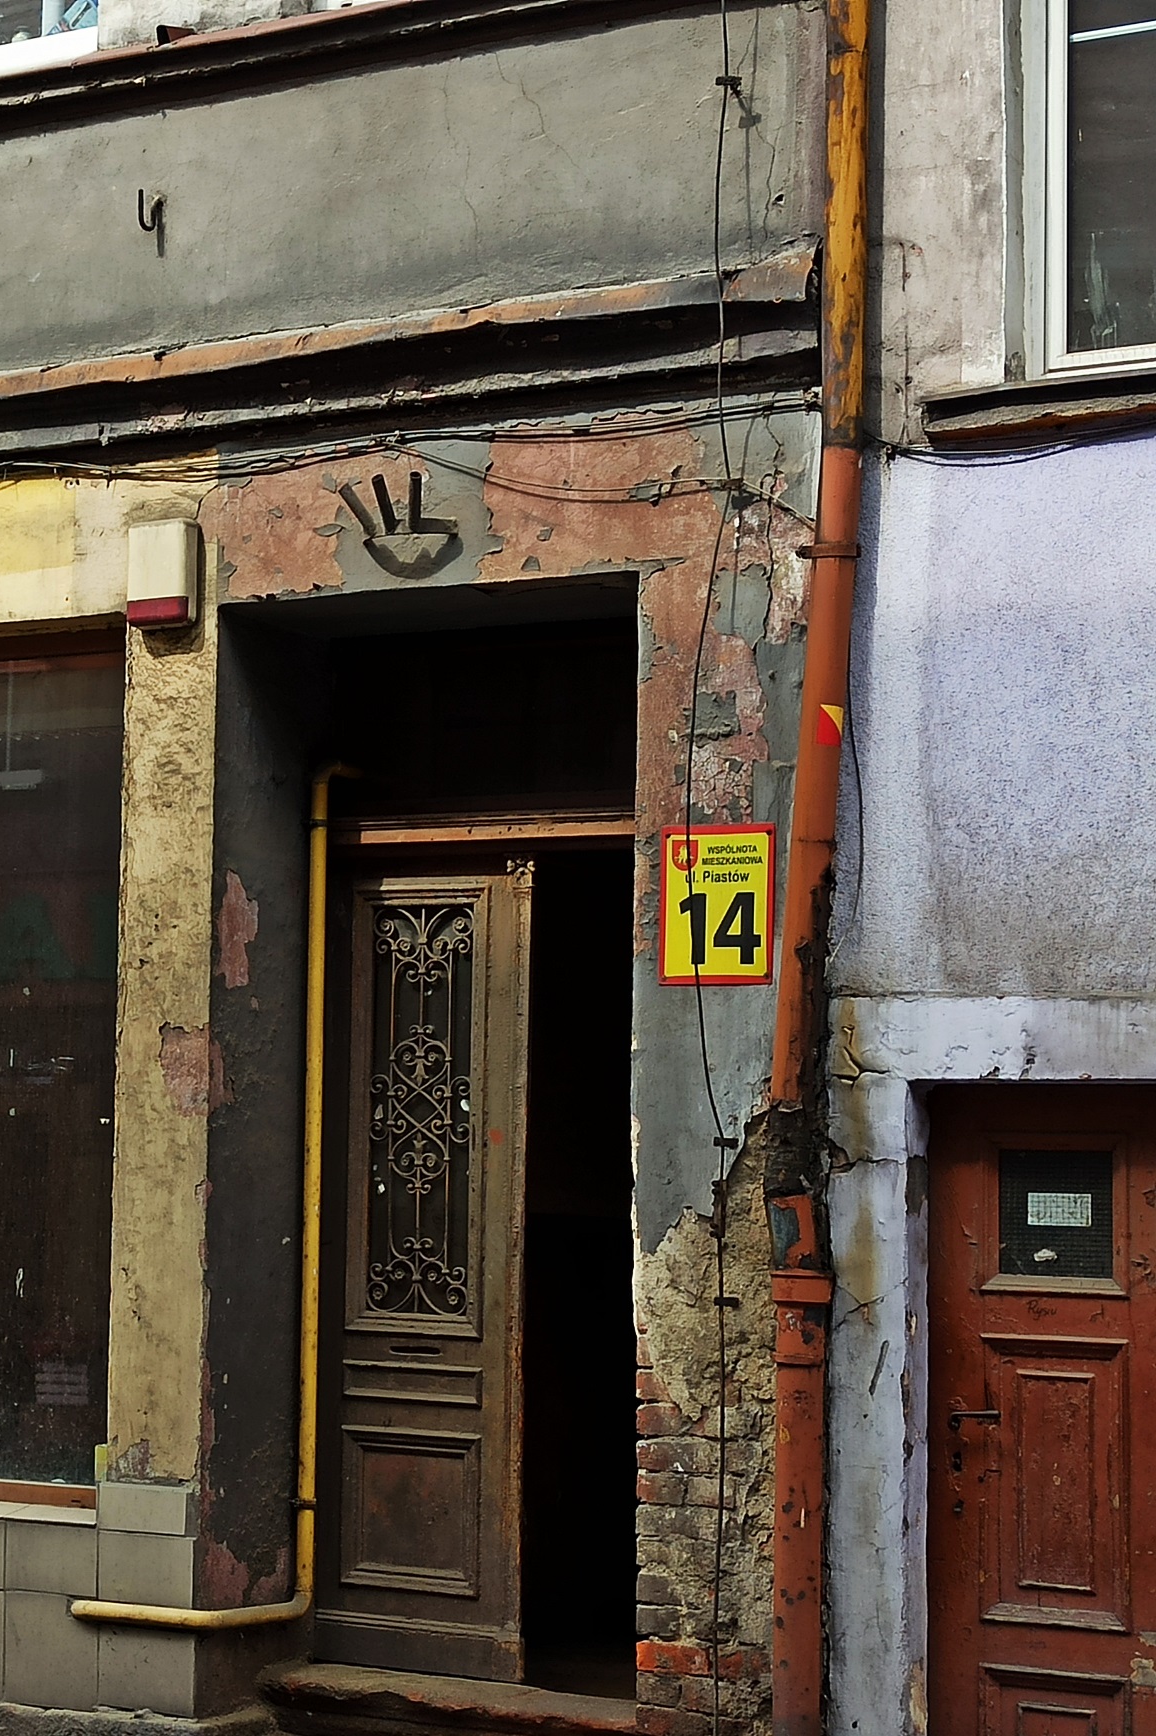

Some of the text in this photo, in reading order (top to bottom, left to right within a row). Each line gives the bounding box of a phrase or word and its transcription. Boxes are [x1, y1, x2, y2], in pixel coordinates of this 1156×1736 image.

[707, 844, 758, 854] WSPÓLNOTA
[702, 856, 763, 866] MIESZKANIOWA
[703, 869, 750, 883] Piastów
[679, 892, 762, 965] 14
